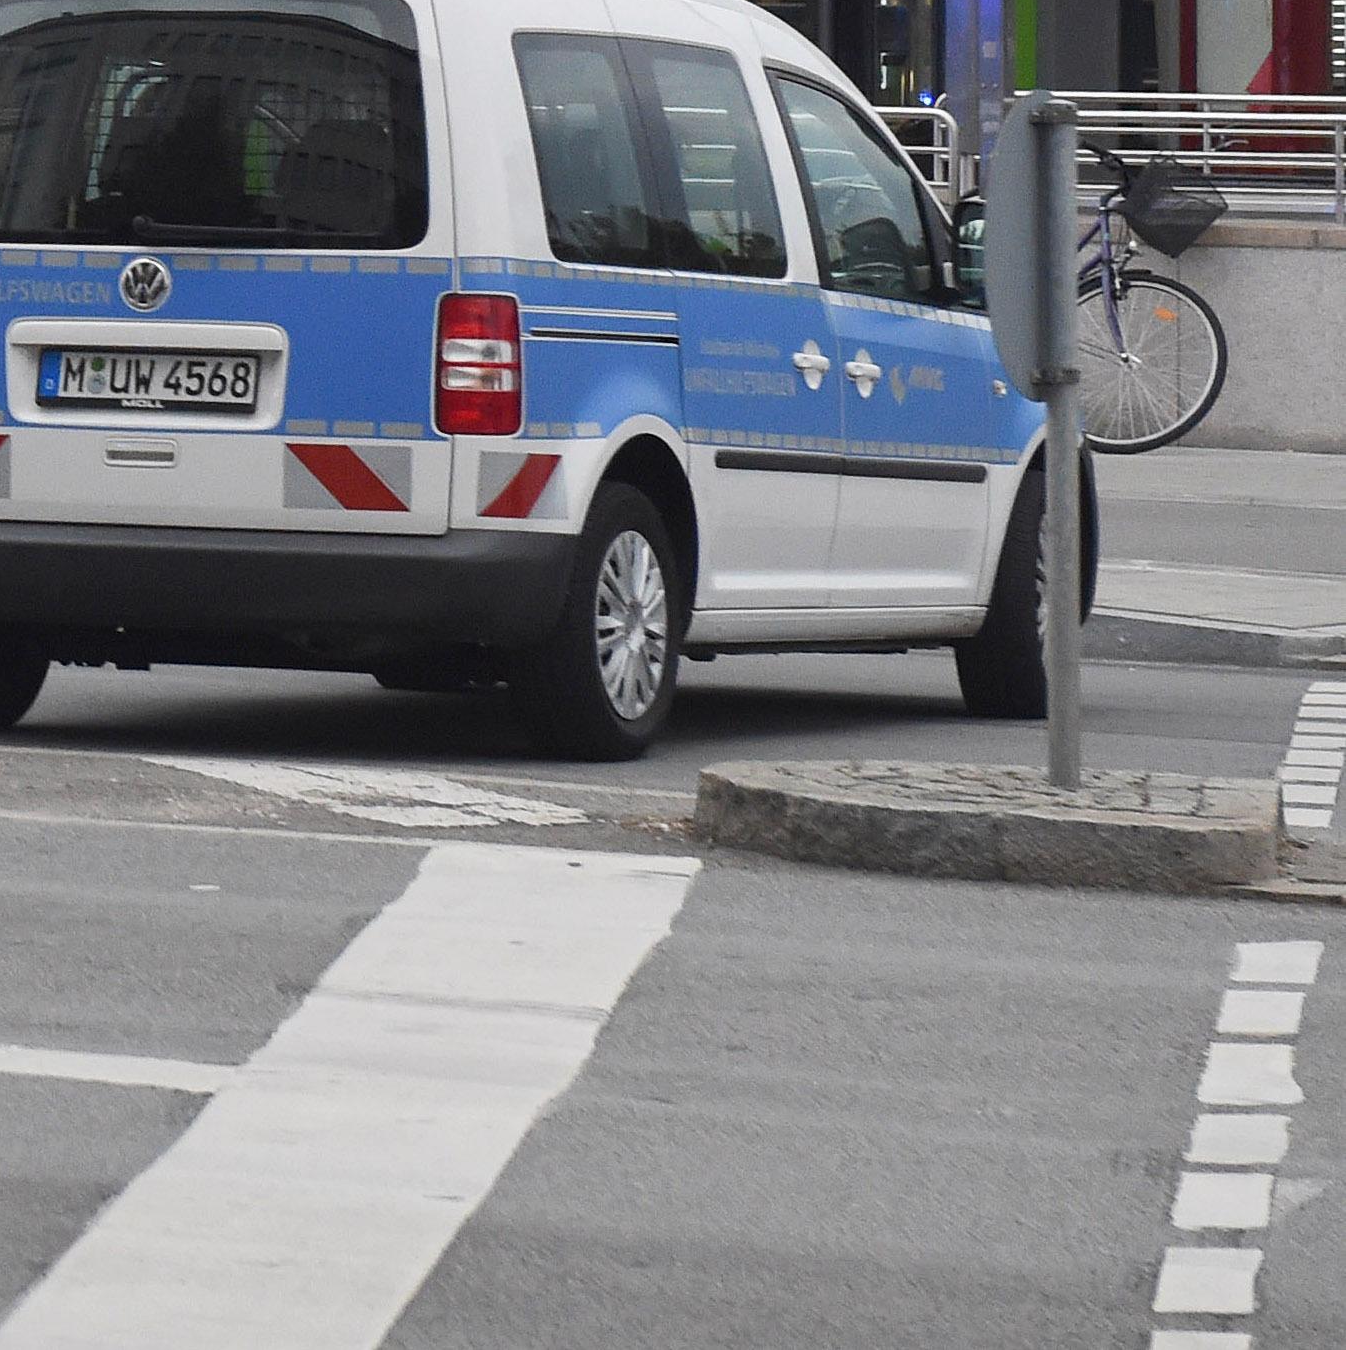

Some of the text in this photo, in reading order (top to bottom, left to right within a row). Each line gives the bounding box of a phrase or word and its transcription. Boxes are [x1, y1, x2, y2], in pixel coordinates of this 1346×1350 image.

[64, 356, 86, 393] M
[110, 358, 153, 395] UW
[163, 360, 250, 398] 4568
